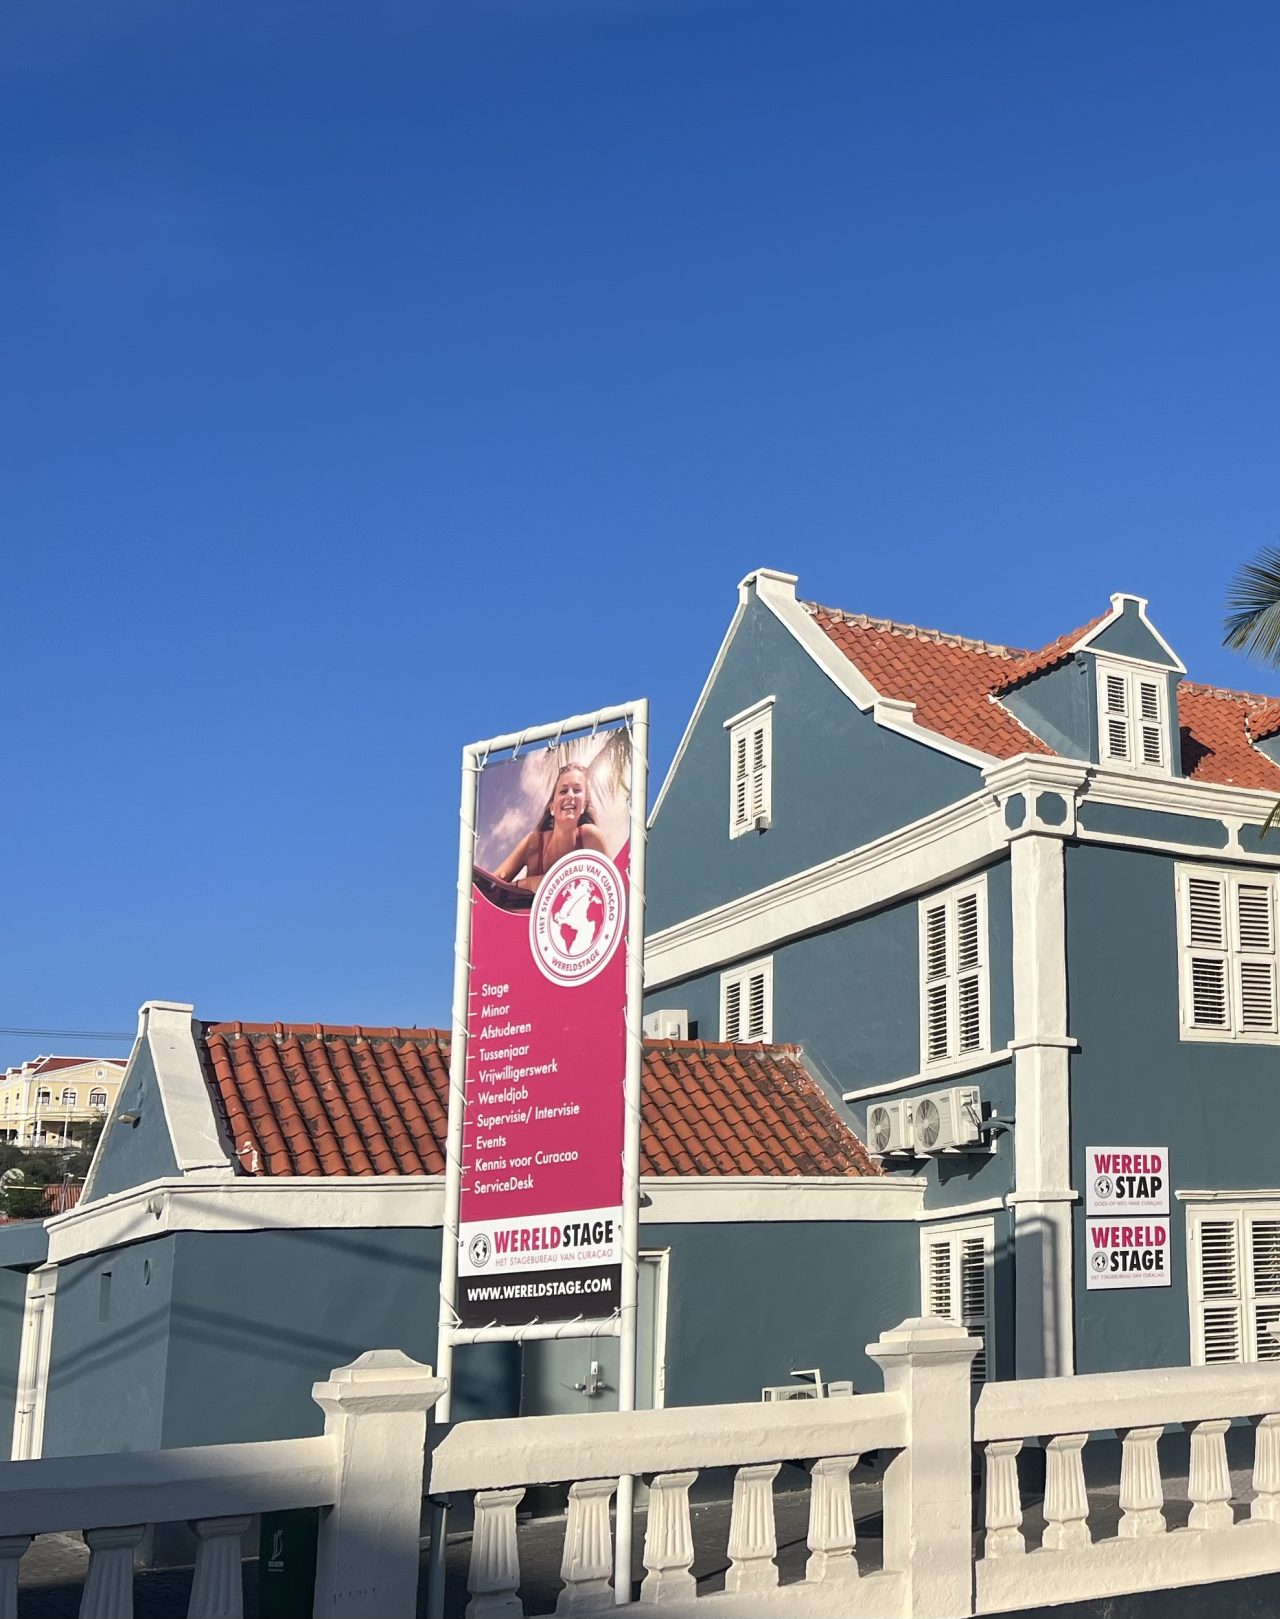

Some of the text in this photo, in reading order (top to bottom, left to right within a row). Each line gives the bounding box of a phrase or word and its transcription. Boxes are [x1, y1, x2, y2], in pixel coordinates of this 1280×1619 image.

[541, 864, 584, 912] STAGEBUREAU
[586, 864, 602, 878] VAN
[600, 875, 615, 921] CURAÇAO
[551, 949, 600, 972] WERELDSTAGE
[481, 983, 509, 998] Stage
[481, 1004, 510, 1018] Minor
[480, 1021, 531, 1040] Afstuderen
[479, 1044, 530, 1061] Tussenjaar
[479, 1058, 558, 1086] Vrijwilligerswerk
[478, 1085, 528, 1104] Wereldjob
[477, 1101, 580, 1130] Supervisie/ Intervisie
[476, 1135, 507, 1150] Events
[475, 1151, 579, 1172] Kennis voor Curacao
[1093, 1154, 1162, 1174] WERELD
[474, 1173, 534, 1195] ServiceDesk
[1115, 1176, 1162, 1199] STAP
[494, 1219, 614, 1254] WERELDSTAGE
[1091, 1226, 1166, 1248] WERELD
[495, 1248, 613, 1267] HET STAGEBUREAU VAN CURAÇAO
[1110, 1249, 1164, 1272] STAGE
[467, 1277, 612, 1302] WWW.WERELDSTAGE.COM
